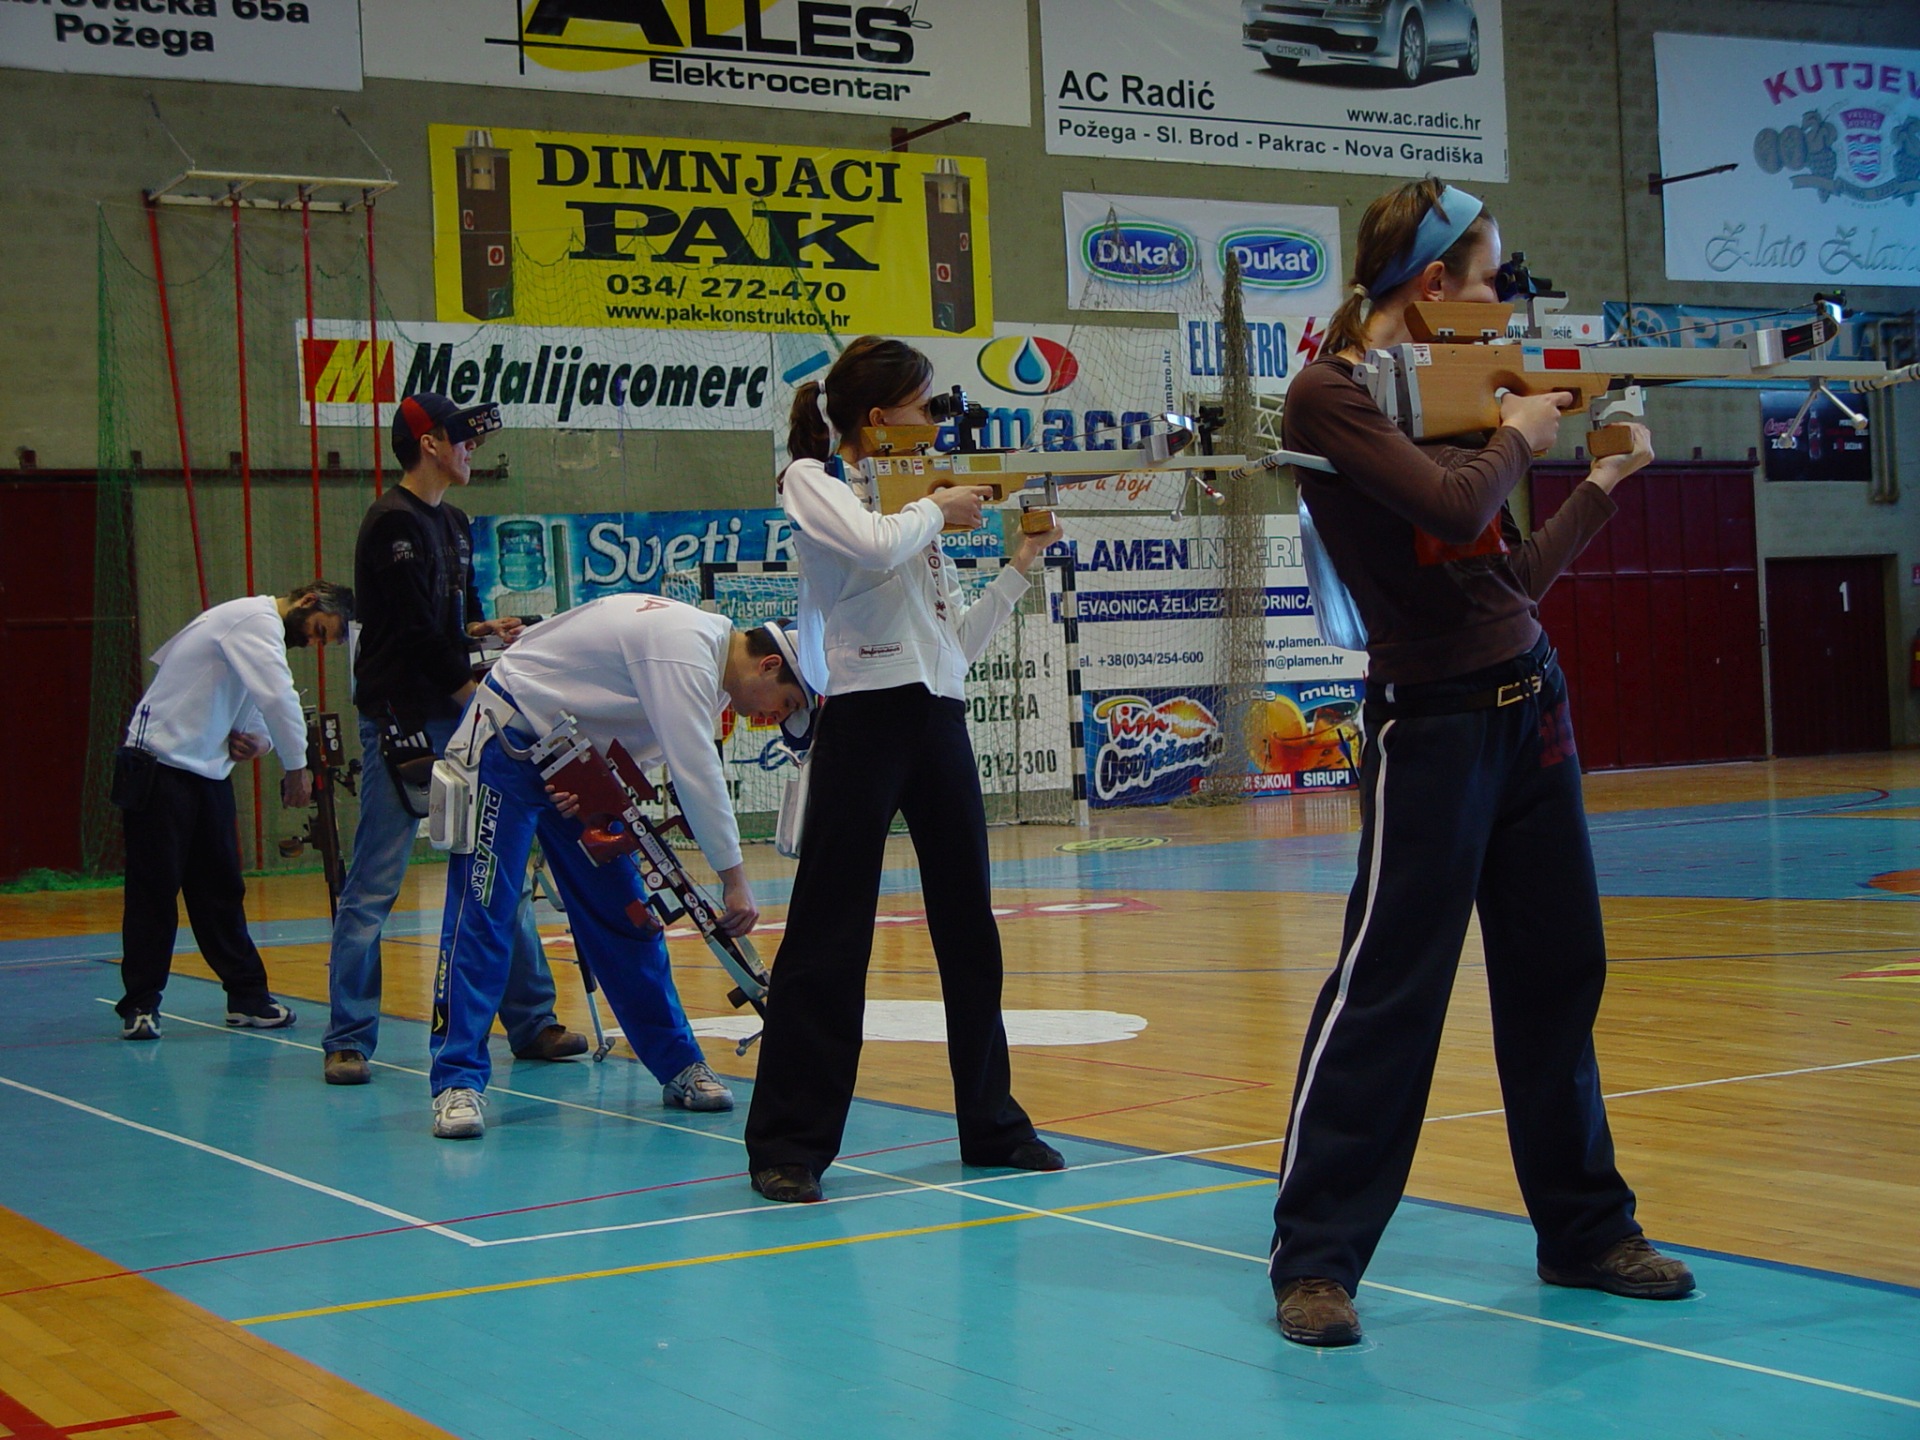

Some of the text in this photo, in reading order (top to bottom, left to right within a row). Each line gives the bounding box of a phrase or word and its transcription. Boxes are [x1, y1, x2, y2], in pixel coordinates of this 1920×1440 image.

[55, 13, 215, 57] Požega
[649, 58, 911, 102] Elektrocentar
[1058, 70, 1215, 110] AC Radić
[1347, 109, 1482, 131] www.ac.radic.hr
[1058, 118, 1136, 144] Požega
[1157, 126, 1182, 144] Sl.
[1190, 128, 1239, 148] Brod
[1258, 133, 1326, 154] Pakrac
[1345, 139, 1393, 159] Nova
[1400, 143, 1483, 165] Gradiška
[535, 142, 903, 204] DIMNJACI
[566, 199, 880, 272] PAK
[1097, 240, 1180, 267] Dukat
[1233, 246, 1311, 273] Dukat
[606, 273, 847, 303] 034/ 272-470
[606, 304, 851, 328] www.pak-konstruktor.hr
[1188, 320, 1289, 379] ELETRO
[403, 341, 769, 423] Metalijacomerc
[583, 516, 741, 583] Sveti
[939, 532, 999, 547] coolers
[1060, 598, 1159, 617] EVAONICA
[1839, 581, 1850, 613] 1
[1079, 651, 1204, 669] el. +38(0)34/254-600
[1300, 683, 1356, 703] multi
[1254, 773, 1291, 789] SOKOVI
[1303, 769, 1350, 787] SIRUPI
